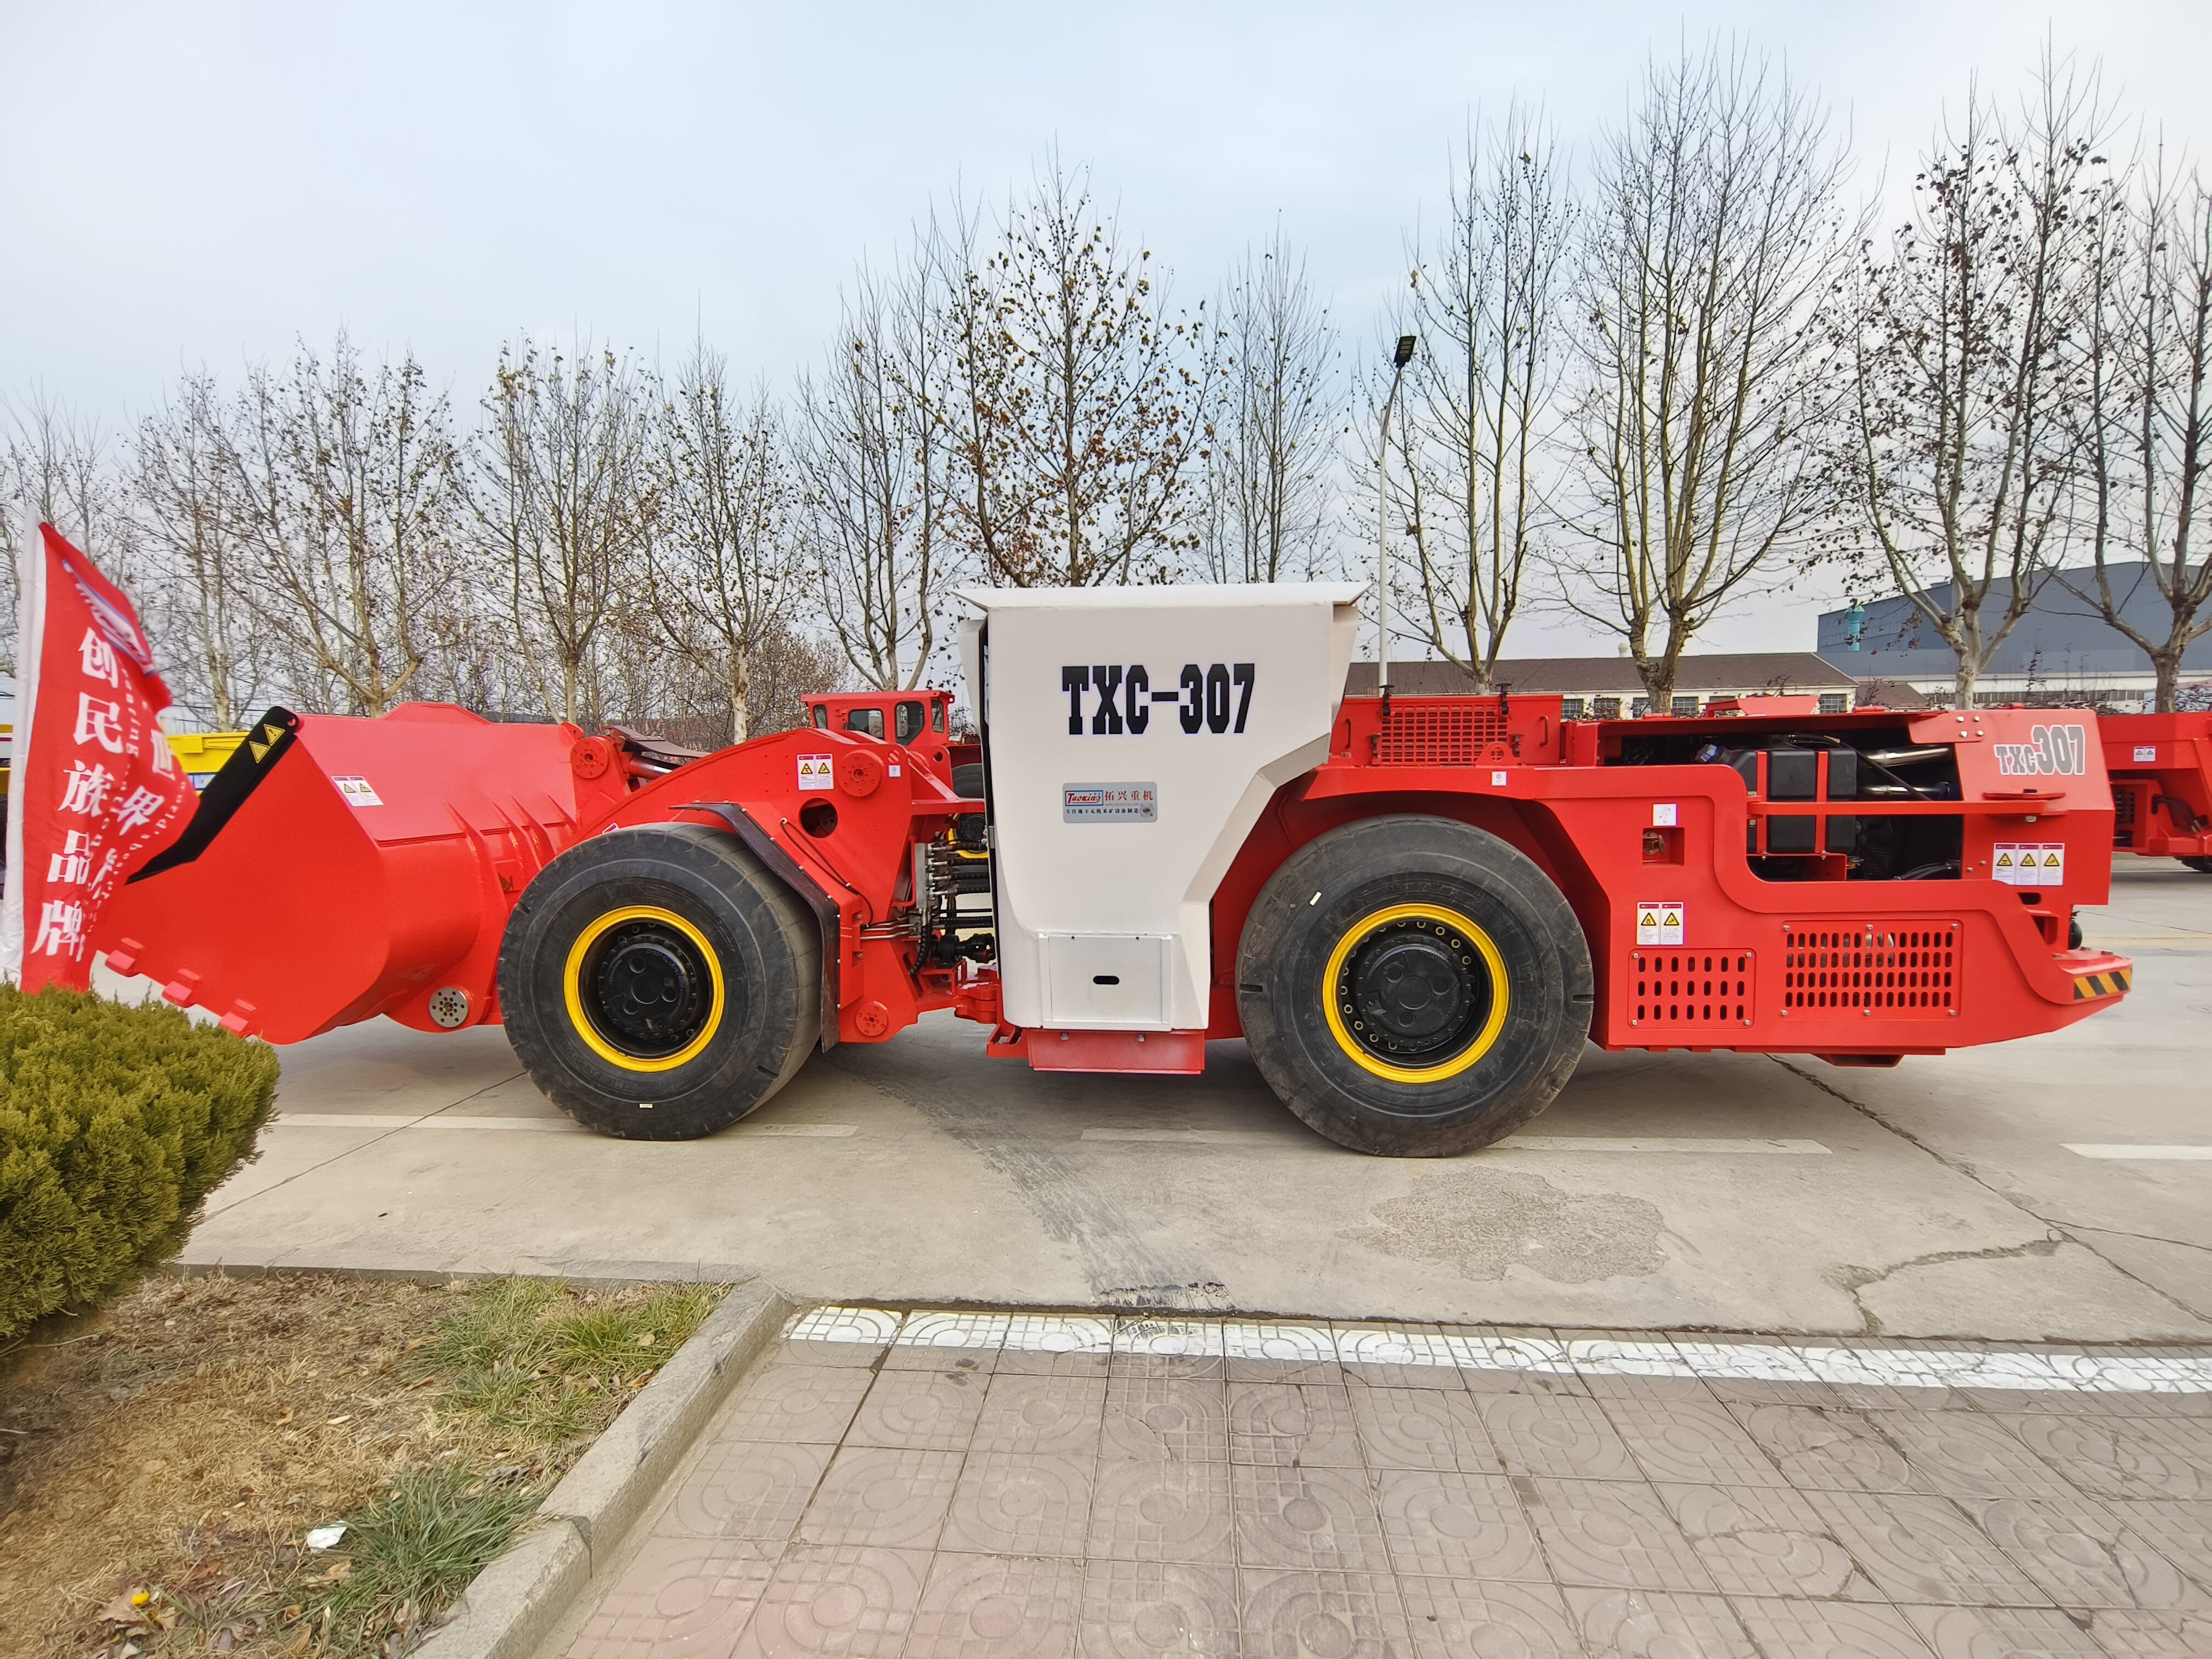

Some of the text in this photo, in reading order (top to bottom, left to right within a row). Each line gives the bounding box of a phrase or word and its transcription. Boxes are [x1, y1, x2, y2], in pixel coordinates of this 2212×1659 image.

[1062, 663, 1255, 735] TXC-307
[30, 627, 123, 962] 创民族品牌
[1105, 790, 1153, 801] 拓兴重机
